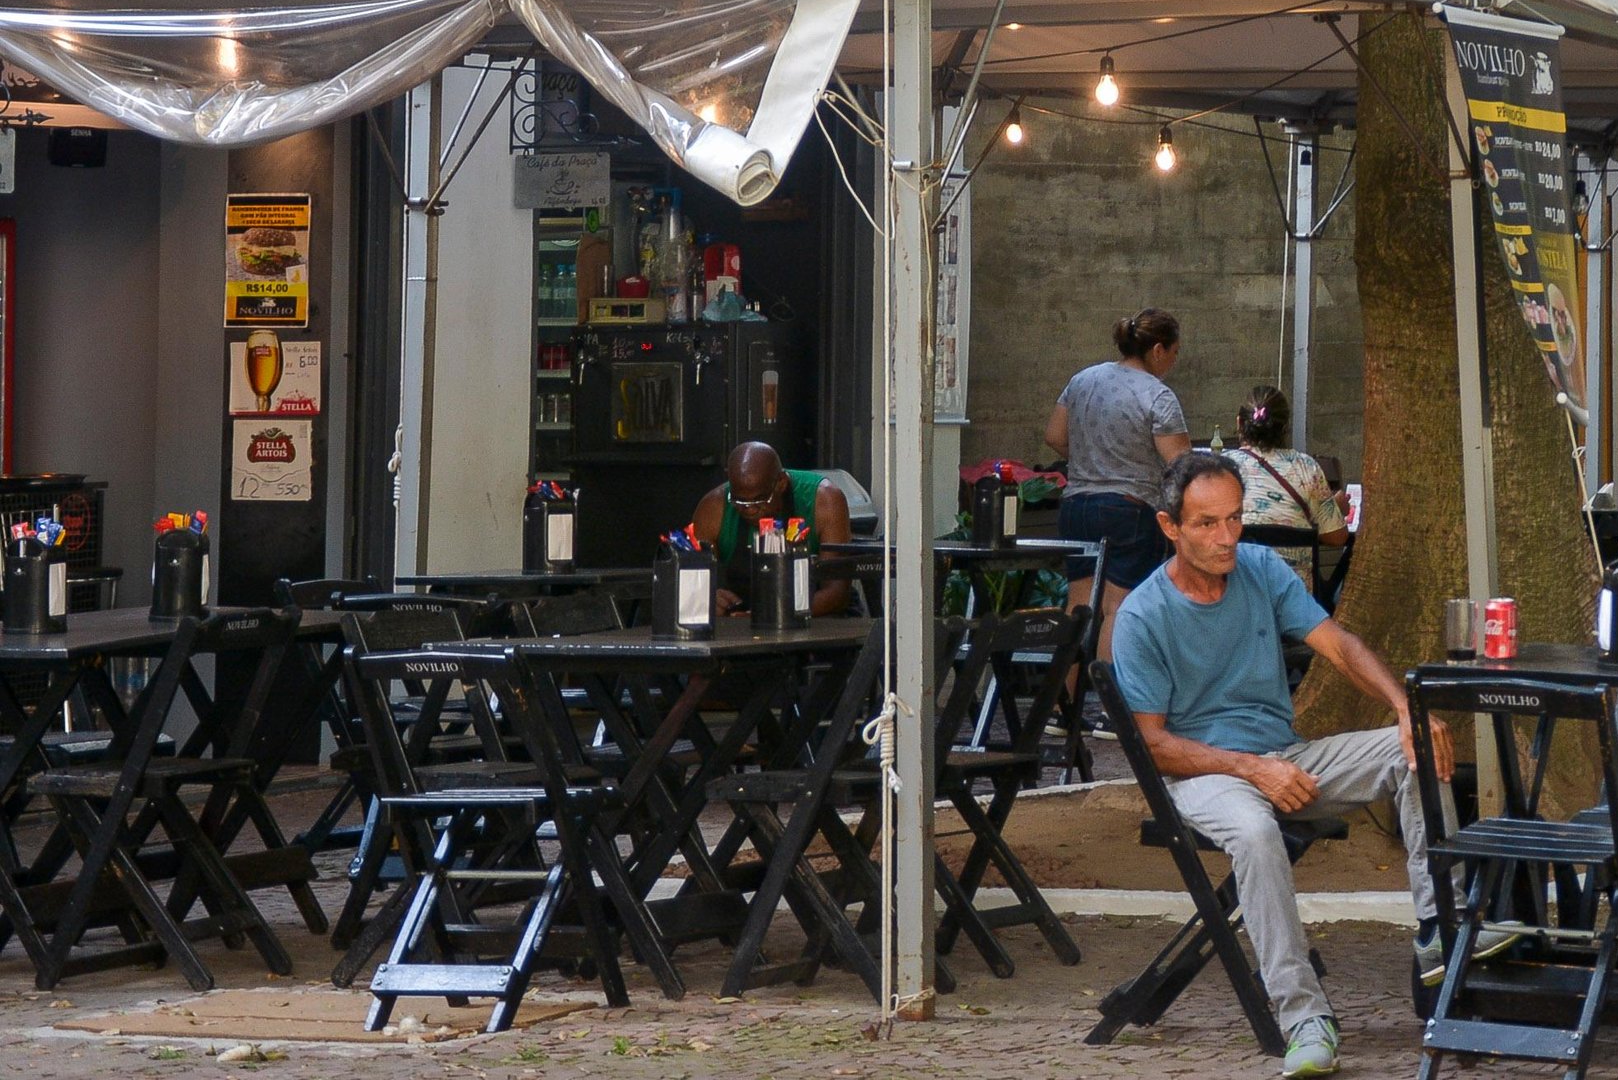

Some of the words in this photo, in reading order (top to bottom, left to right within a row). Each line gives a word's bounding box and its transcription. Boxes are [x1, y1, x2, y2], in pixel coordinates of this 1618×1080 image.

[1455, 40, 1526, 77] NOVILHO
[246, 283, 289, 294] R$14,00
[239, 306, 294, 315] NOVILHO
[281, 403, 312, 411] STELLA
[256, 441, 288, 449] STELLA
[255, 449, 288, 457] ARTOIS
[855, 563, 896, 572] NOVILO
[405, 662, 459, 673] NOVILHO
[1478, 693, 1540, 707] NOVILHO
